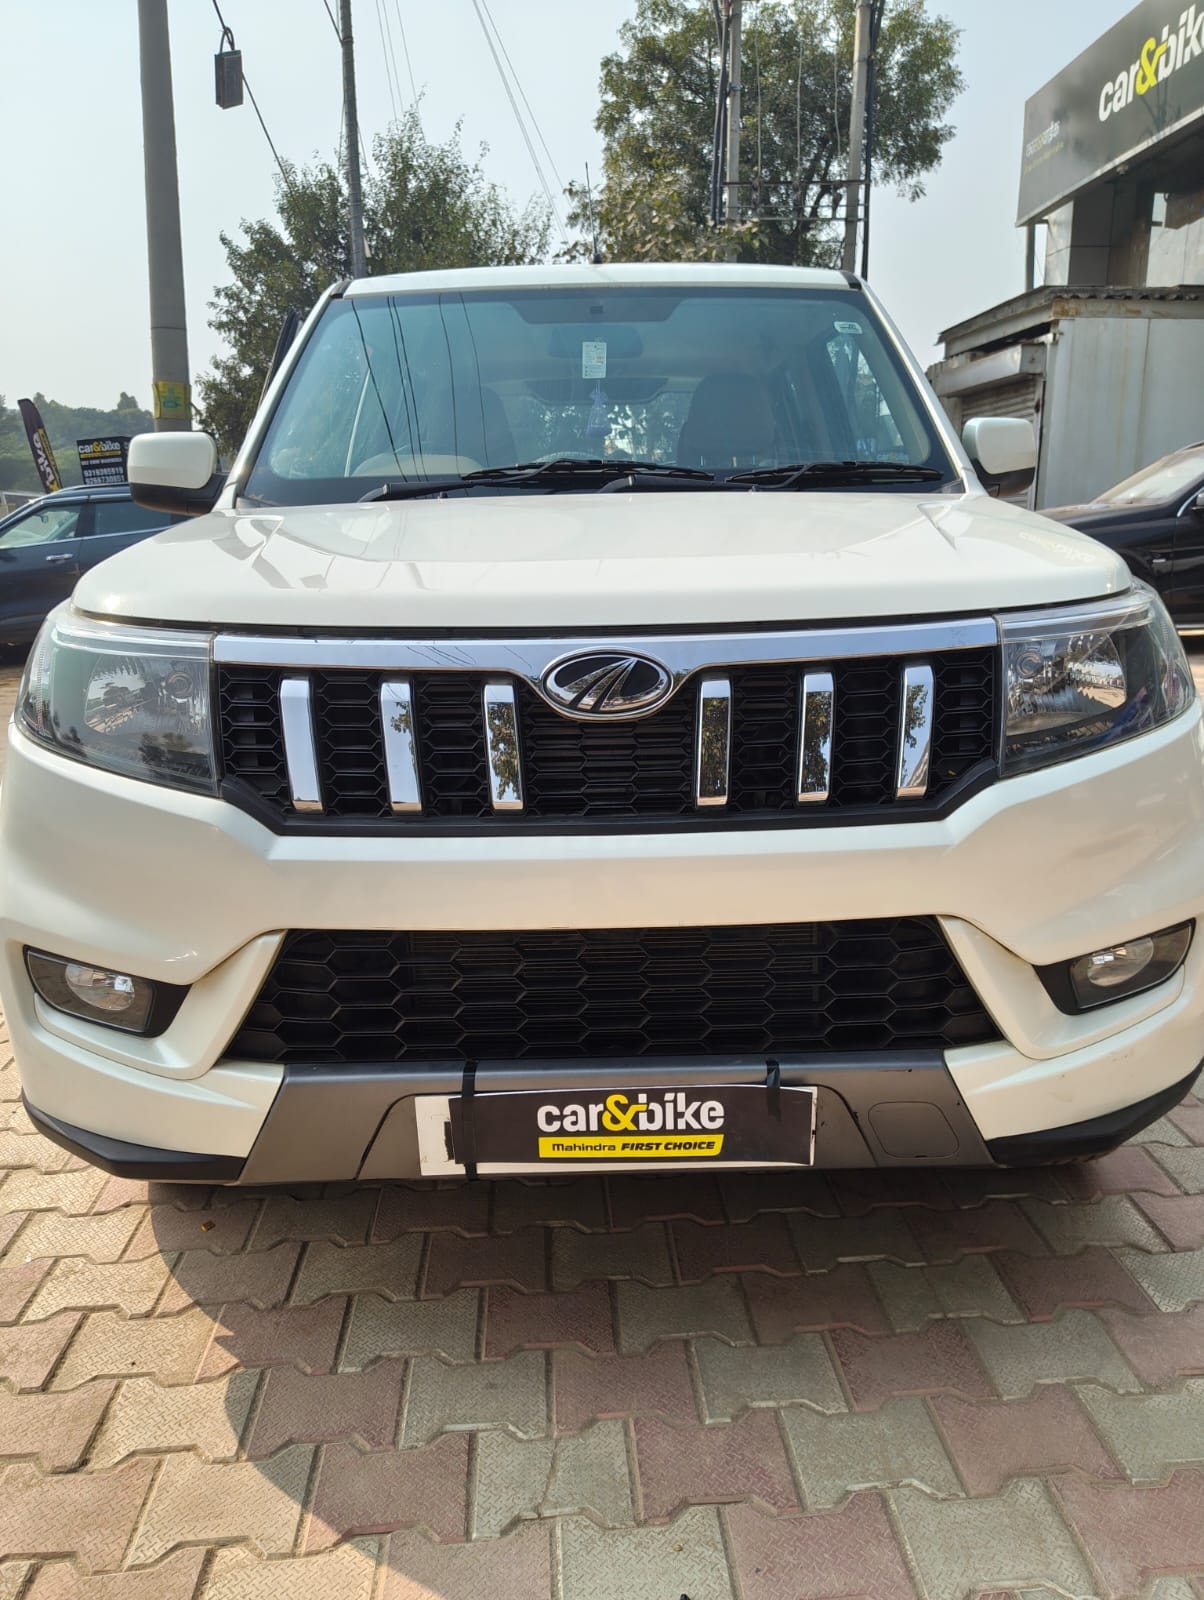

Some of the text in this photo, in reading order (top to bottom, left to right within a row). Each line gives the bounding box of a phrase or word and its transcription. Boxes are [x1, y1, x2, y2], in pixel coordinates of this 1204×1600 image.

[79, 440, 121, 453] car&bike
[537, 1092, 725, 1133] car&bike
[552, 1141, 716, 1152] Mahindra FIRST CHOICE
